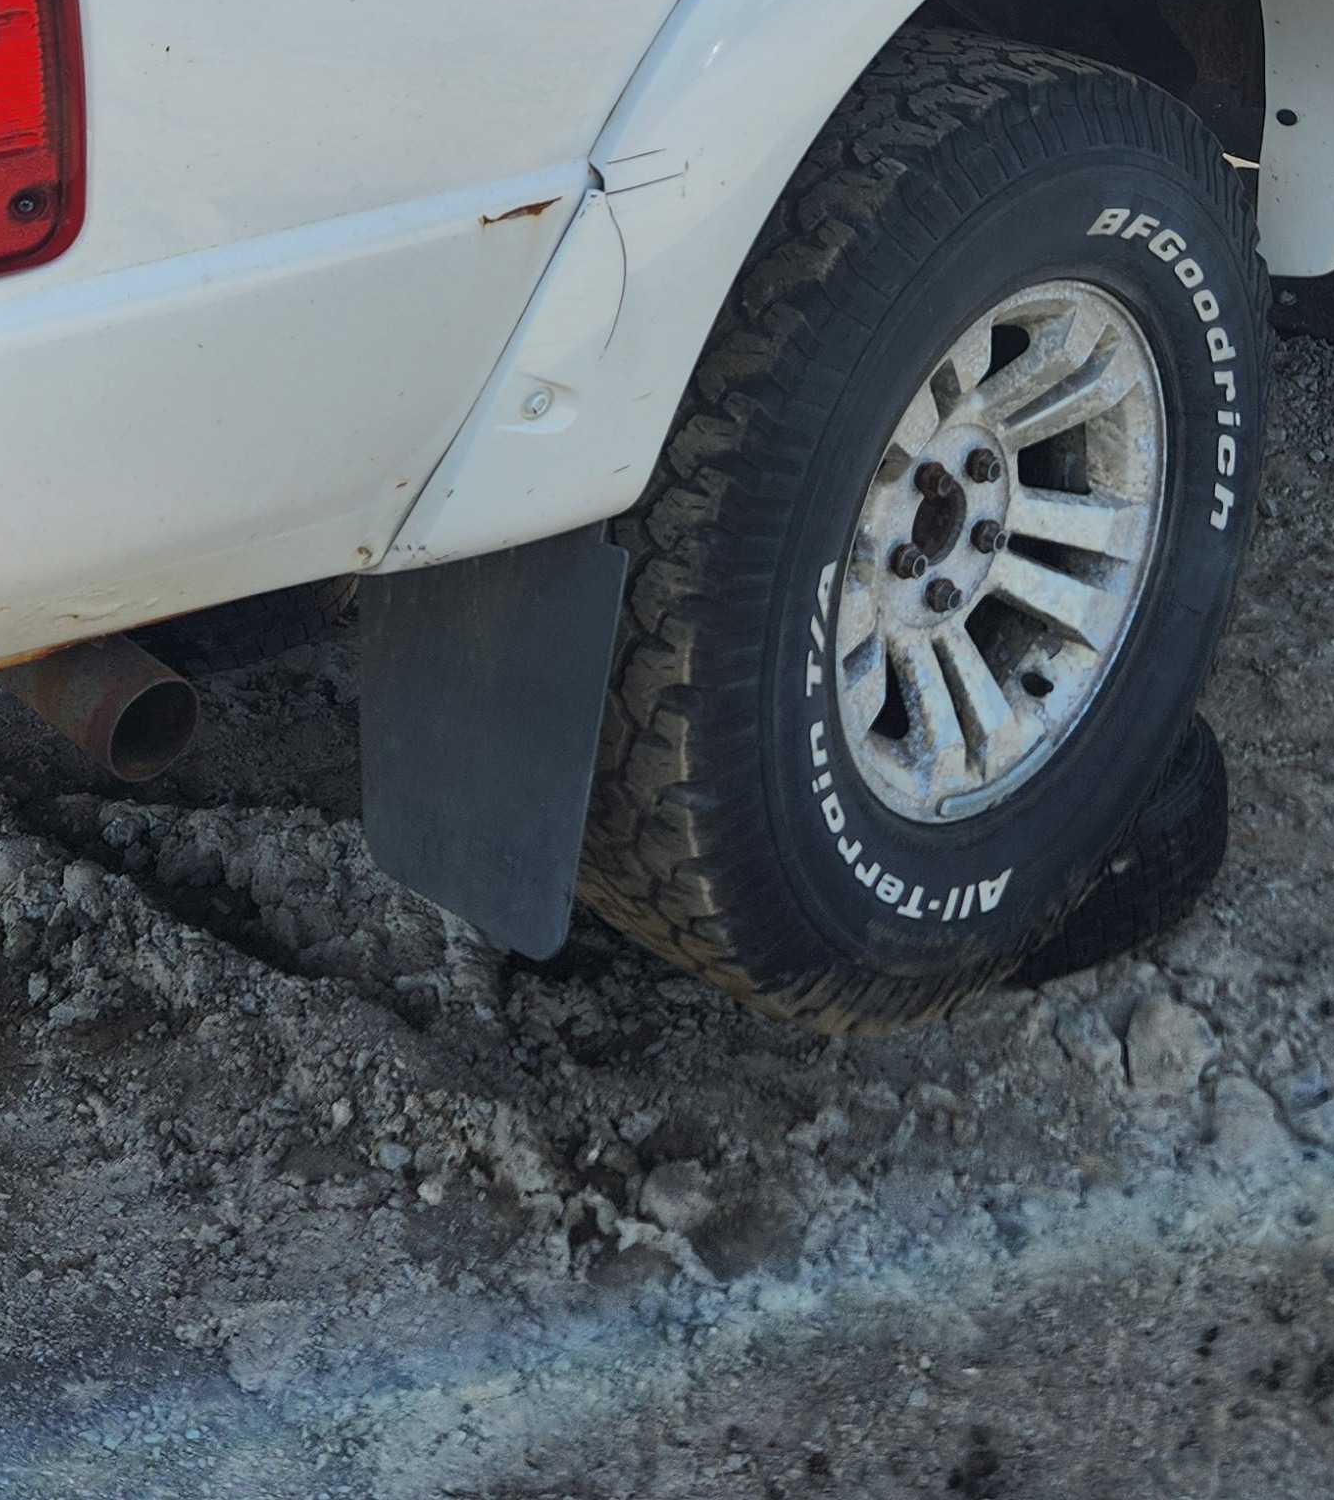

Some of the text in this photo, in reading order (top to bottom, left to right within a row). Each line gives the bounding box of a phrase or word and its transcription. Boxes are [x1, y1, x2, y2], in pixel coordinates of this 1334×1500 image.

[1086, 207, 1241, 532] BFGoodrich
[805, 560, 1013, 923] All-Terrain T/A
